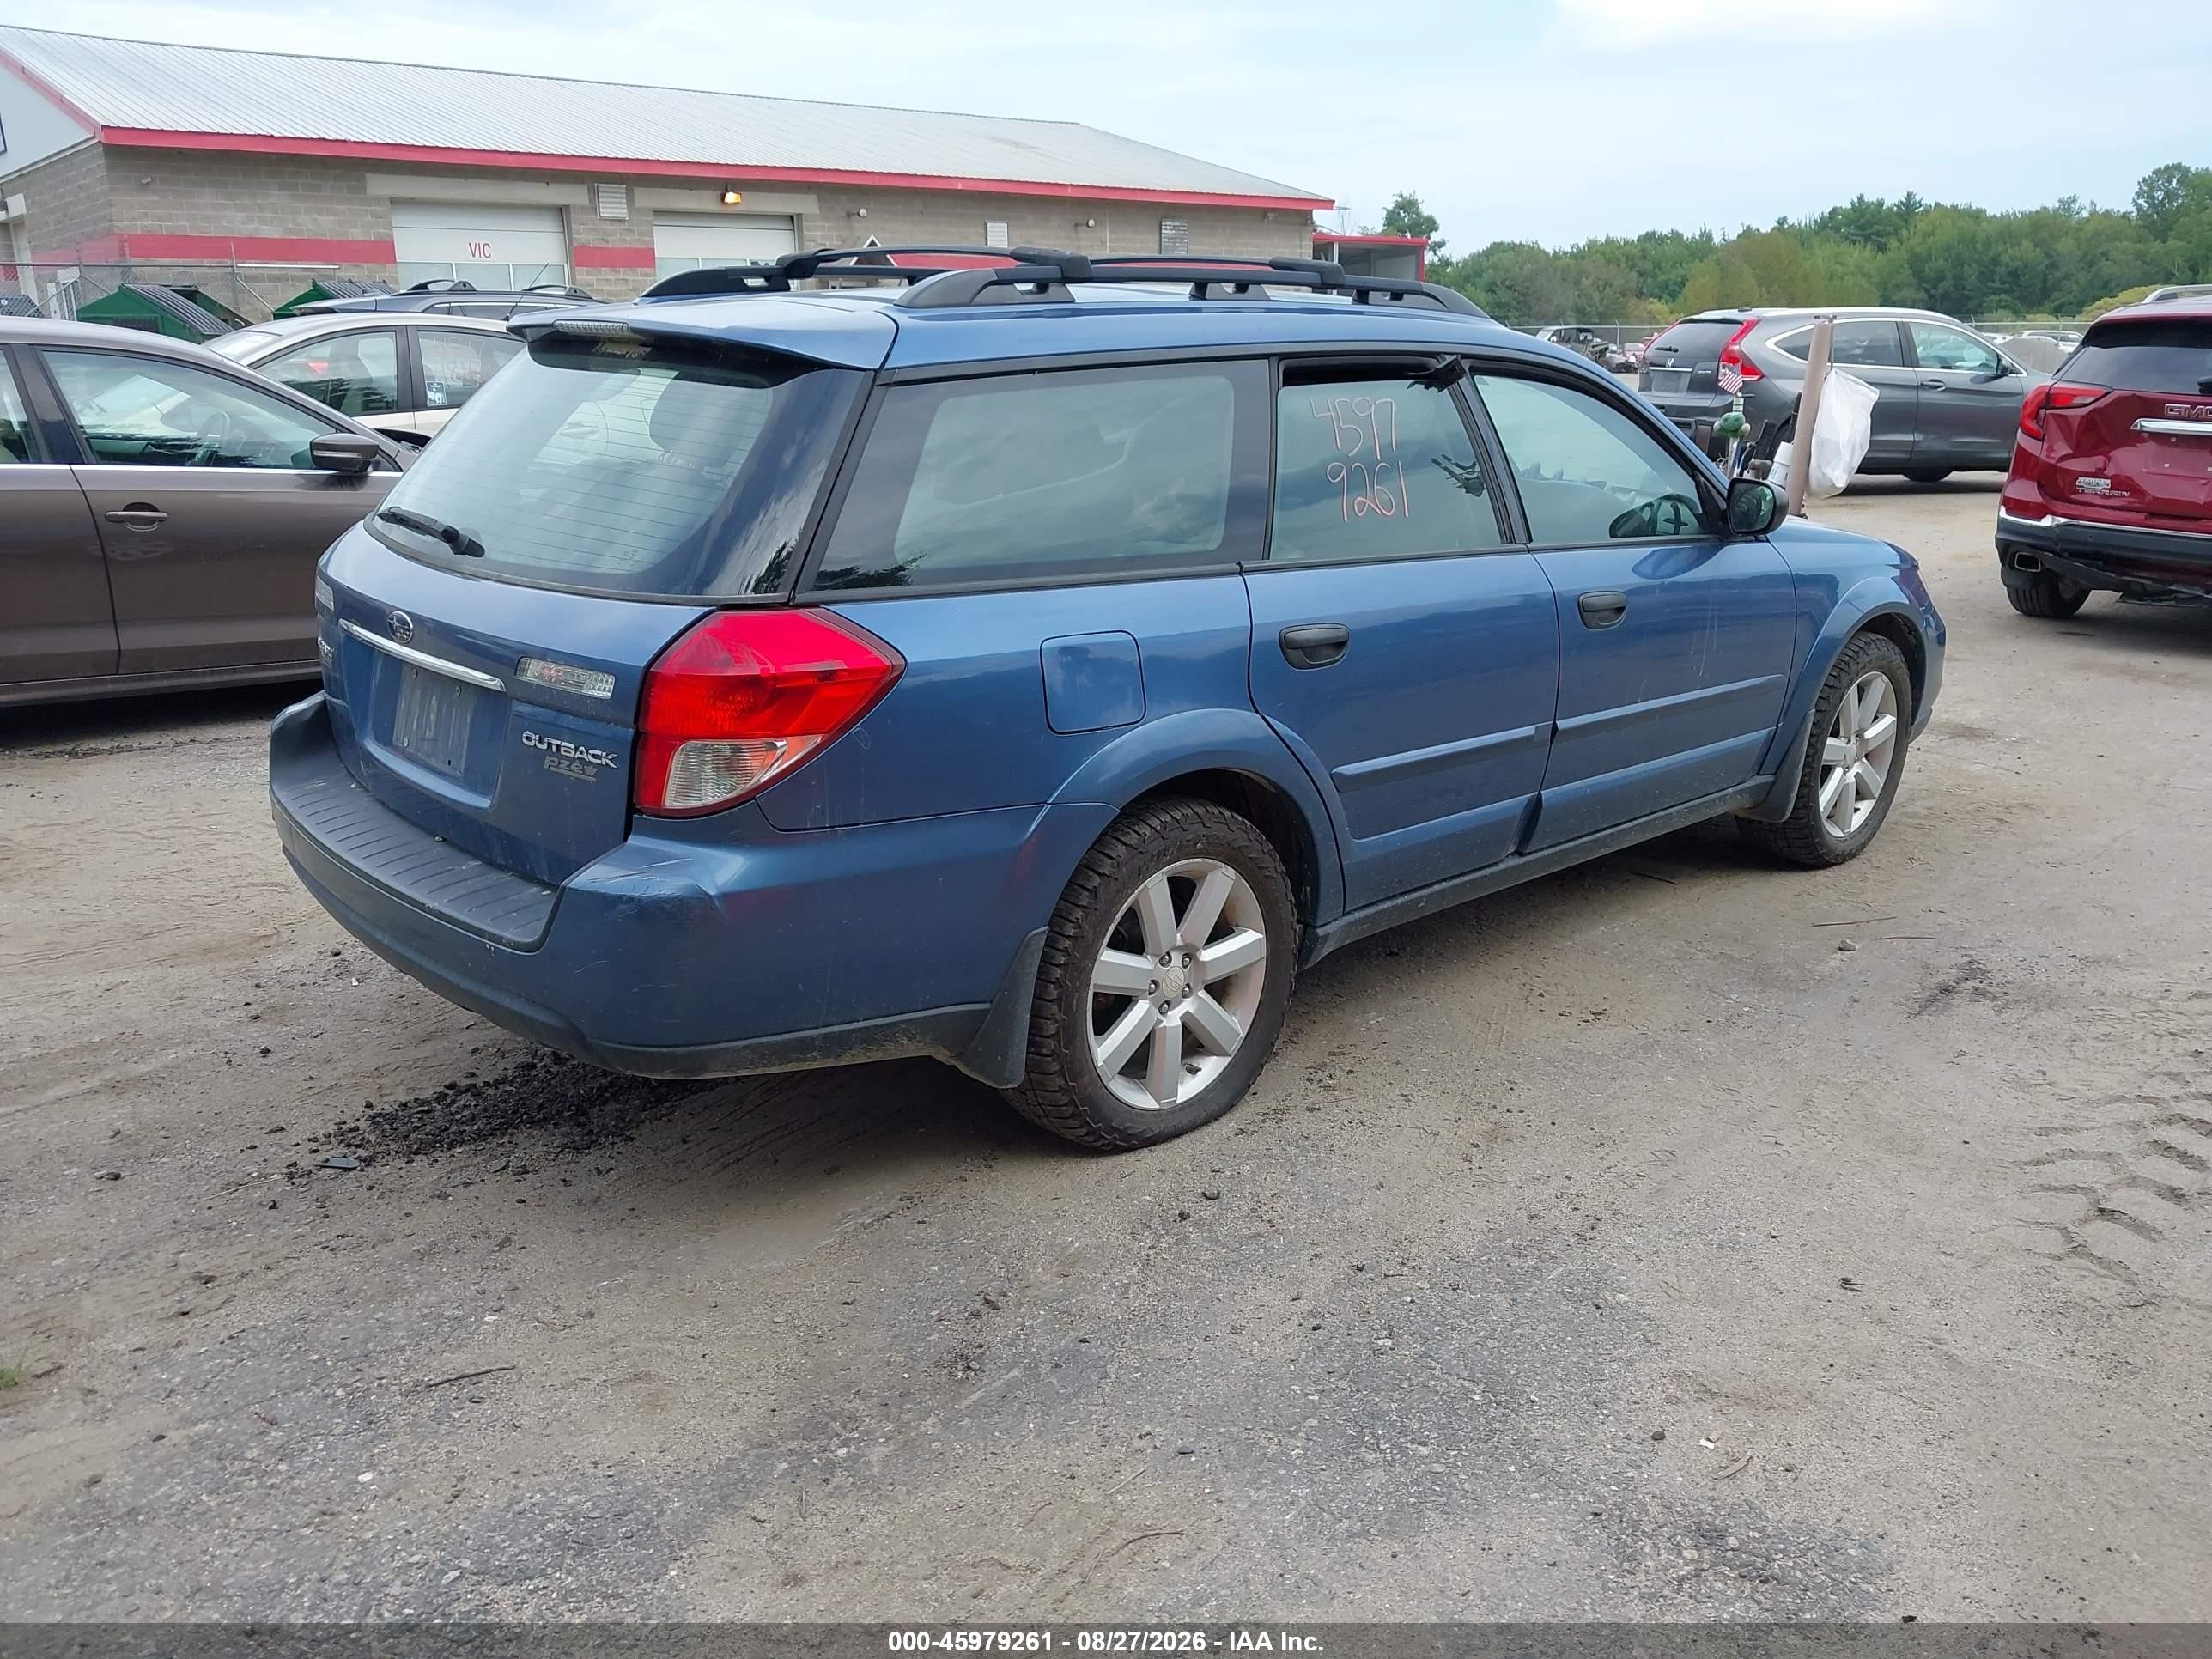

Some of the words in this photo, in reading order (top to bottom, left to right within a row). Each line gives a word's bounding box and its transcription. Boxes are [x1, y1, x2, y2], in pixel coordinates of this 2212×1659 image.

[468, 241, 492, 259] VIC
[1309, 397, 1397, 461] 4597
[1326, 459, 1410, 523] 9261
[521, 730, 618, 769] OUTBACK
